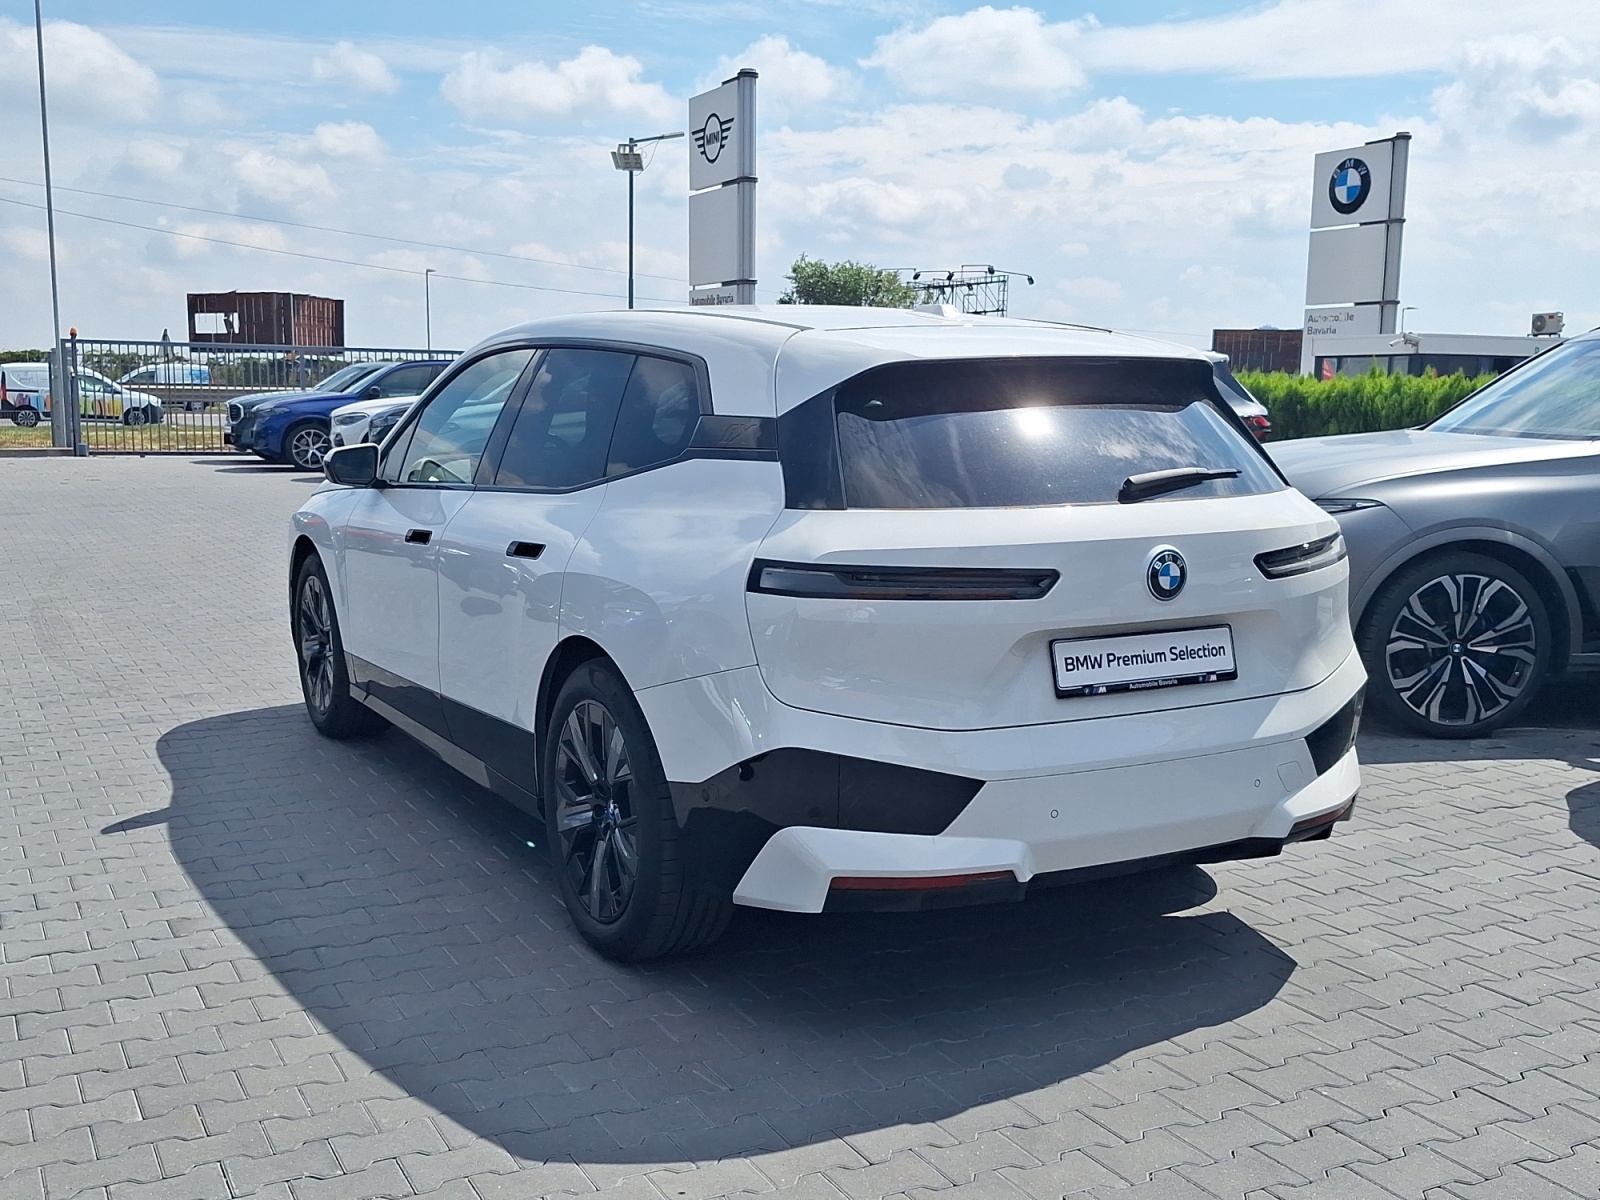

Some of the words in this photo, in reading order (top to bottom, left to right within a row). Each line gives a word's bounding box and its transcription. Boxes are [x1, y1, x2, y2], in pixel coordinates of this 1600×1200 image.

[705, 130, 720, 147] MINI
[1332, 158, 1368, 179] BMW
[1307, 325, 1337, 335] Bavaria
[1153, 554, 1184, 570] BMW
[1064, 653, 1103, 673] BMW
[1106, 649, 1167, 668] Premium
[1169, 643, 1226, 661] Selection
[1129, 680, 1158, 690] Automobile
[1158, 678, 1178, 687] Bavaria
